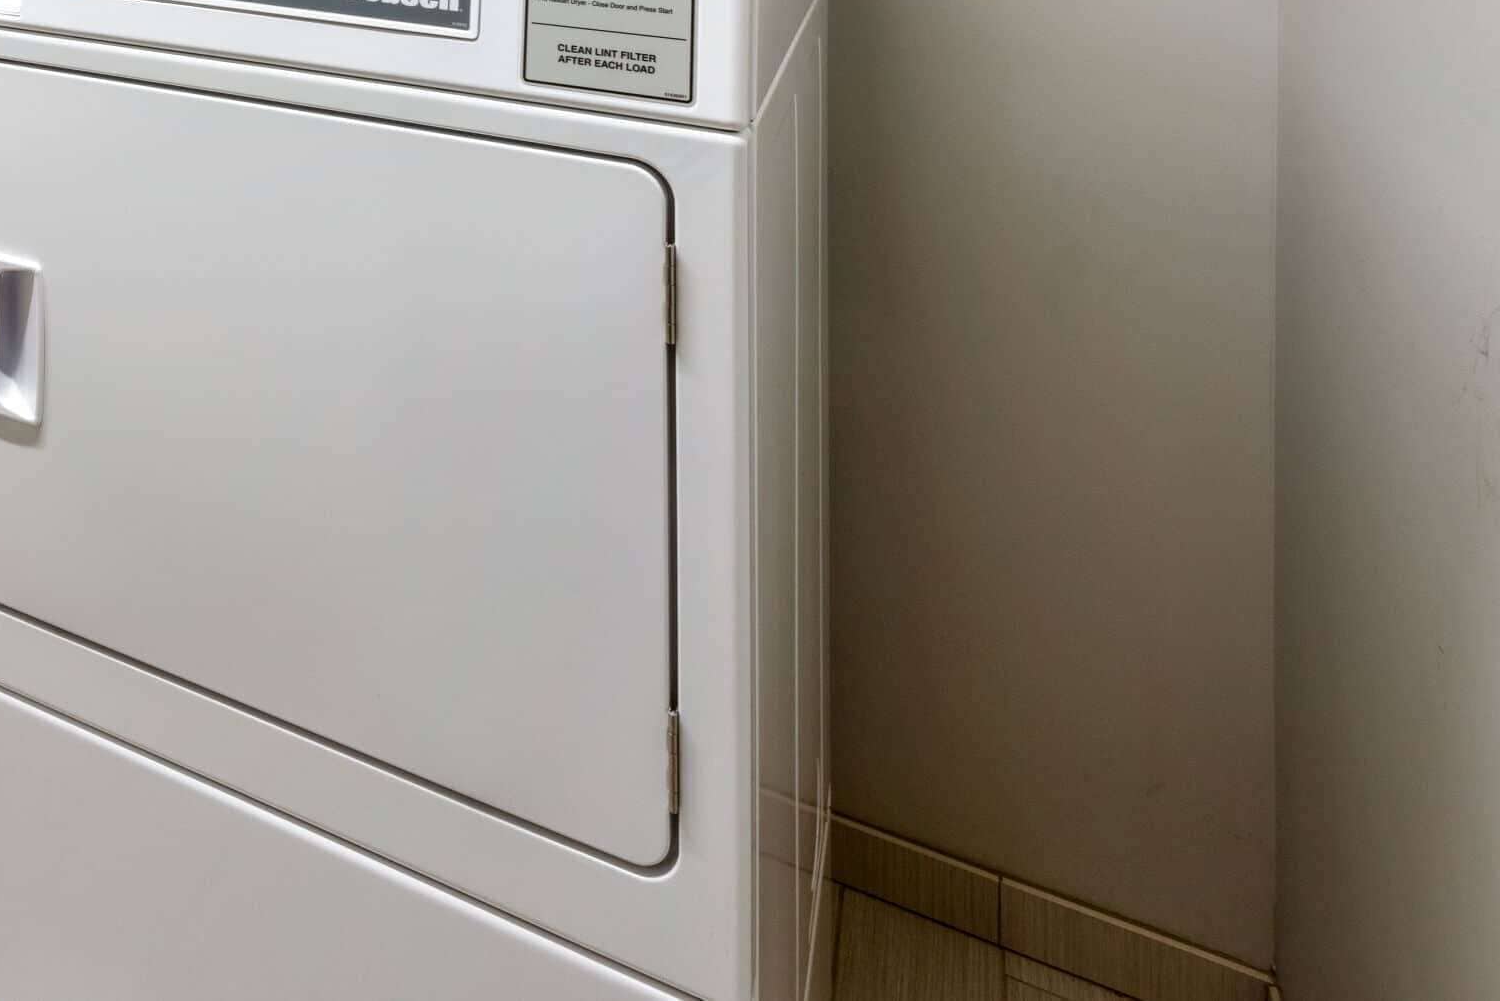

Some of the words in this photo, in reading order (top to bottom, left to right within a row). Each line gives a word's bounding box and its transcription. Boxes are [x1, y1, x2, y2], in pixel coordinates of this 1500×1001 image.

[609, 1, 625, 10] Door
[626, 3, 638, 11] and
[657, 6, 673, 15] Start
[557, 43, 593, 55] CLEAN
[595, 47, 618, 58] LINT
[620, 50, 657, 63] FILTER
[557, 55, 592, 67] AFTER
[594, 59, 623, 70] EACH
[625, 63, 656, 74] LOAD
